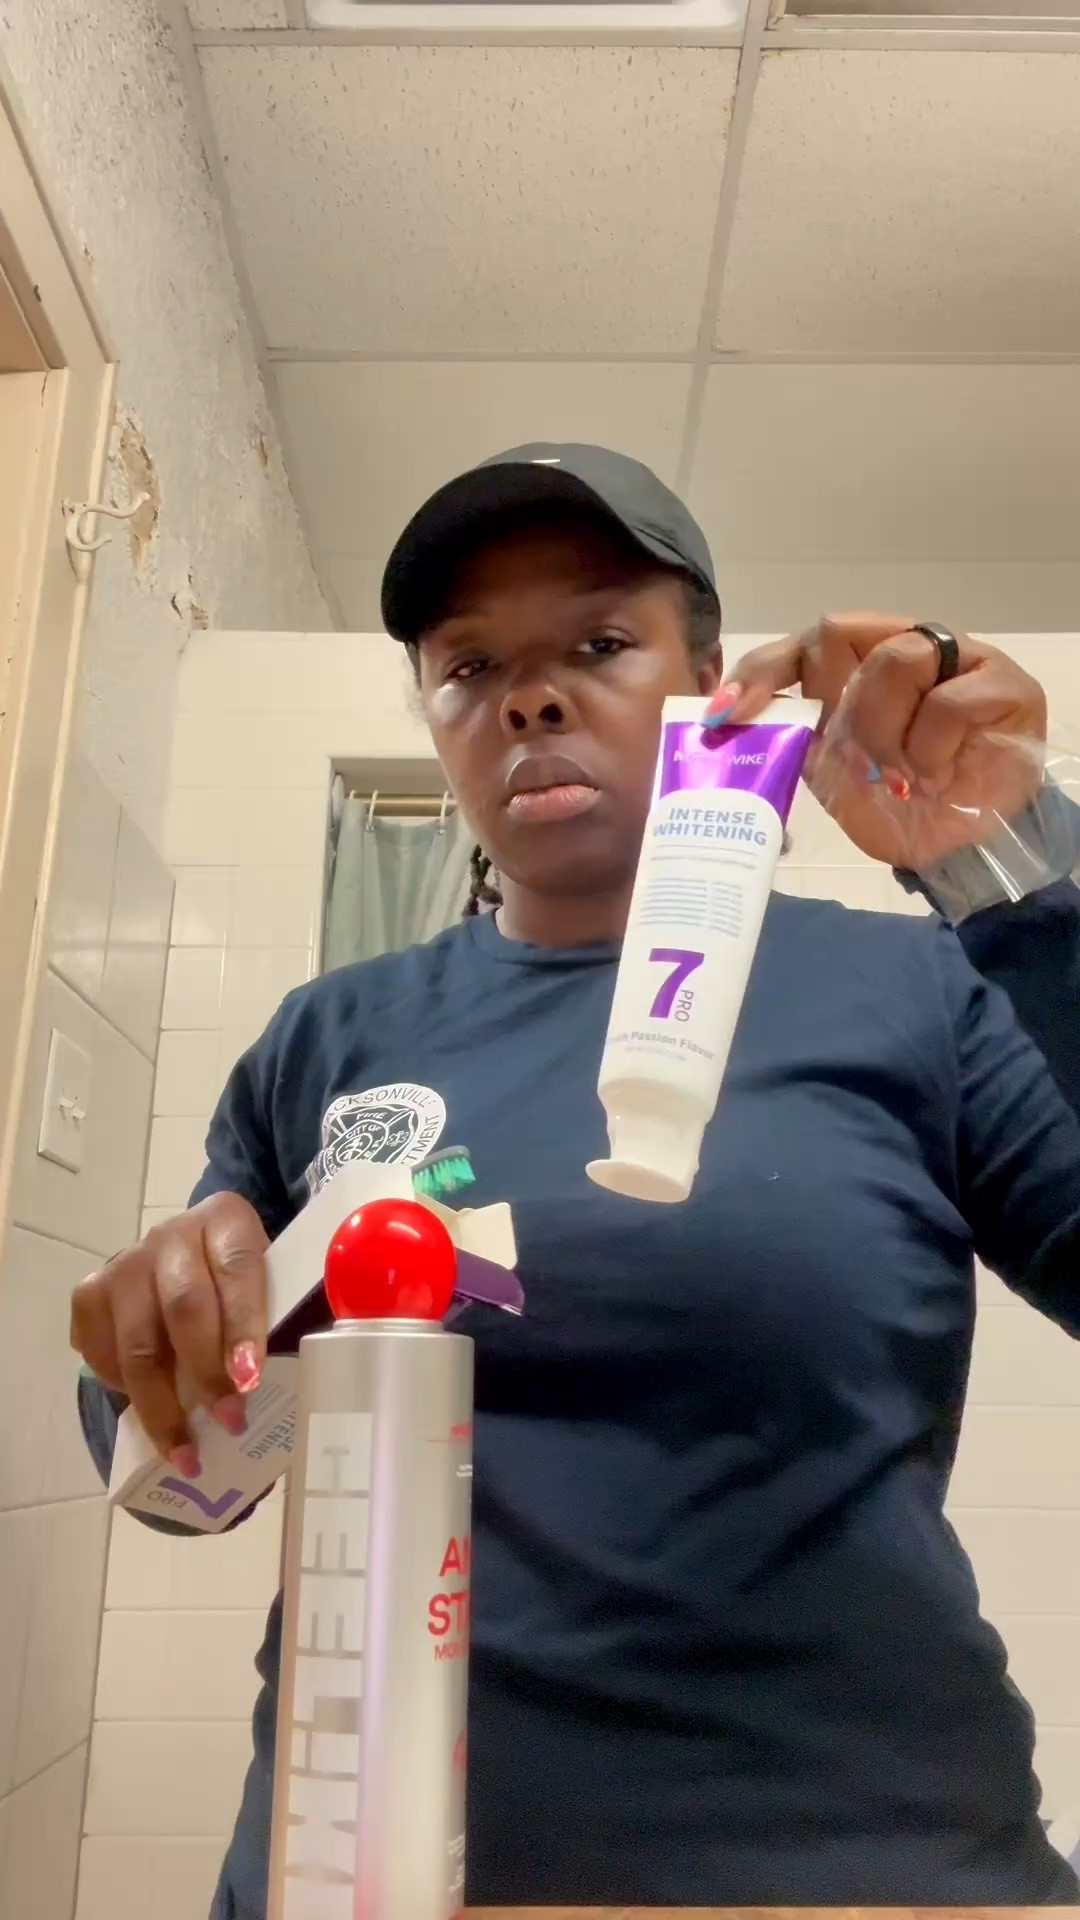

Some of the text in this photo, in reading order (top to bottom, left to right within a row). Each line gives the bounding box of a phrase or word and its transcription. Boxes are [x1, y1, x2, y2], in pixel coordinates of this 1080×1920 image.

[652, 822, 768, 847] WHITENING
[668, 808, 757, 826] INTENSE
[648, 947, 705, 1019] 7
[674, 988, 695, 1023] PRO
[157, 1476, 245, 1520] 7
